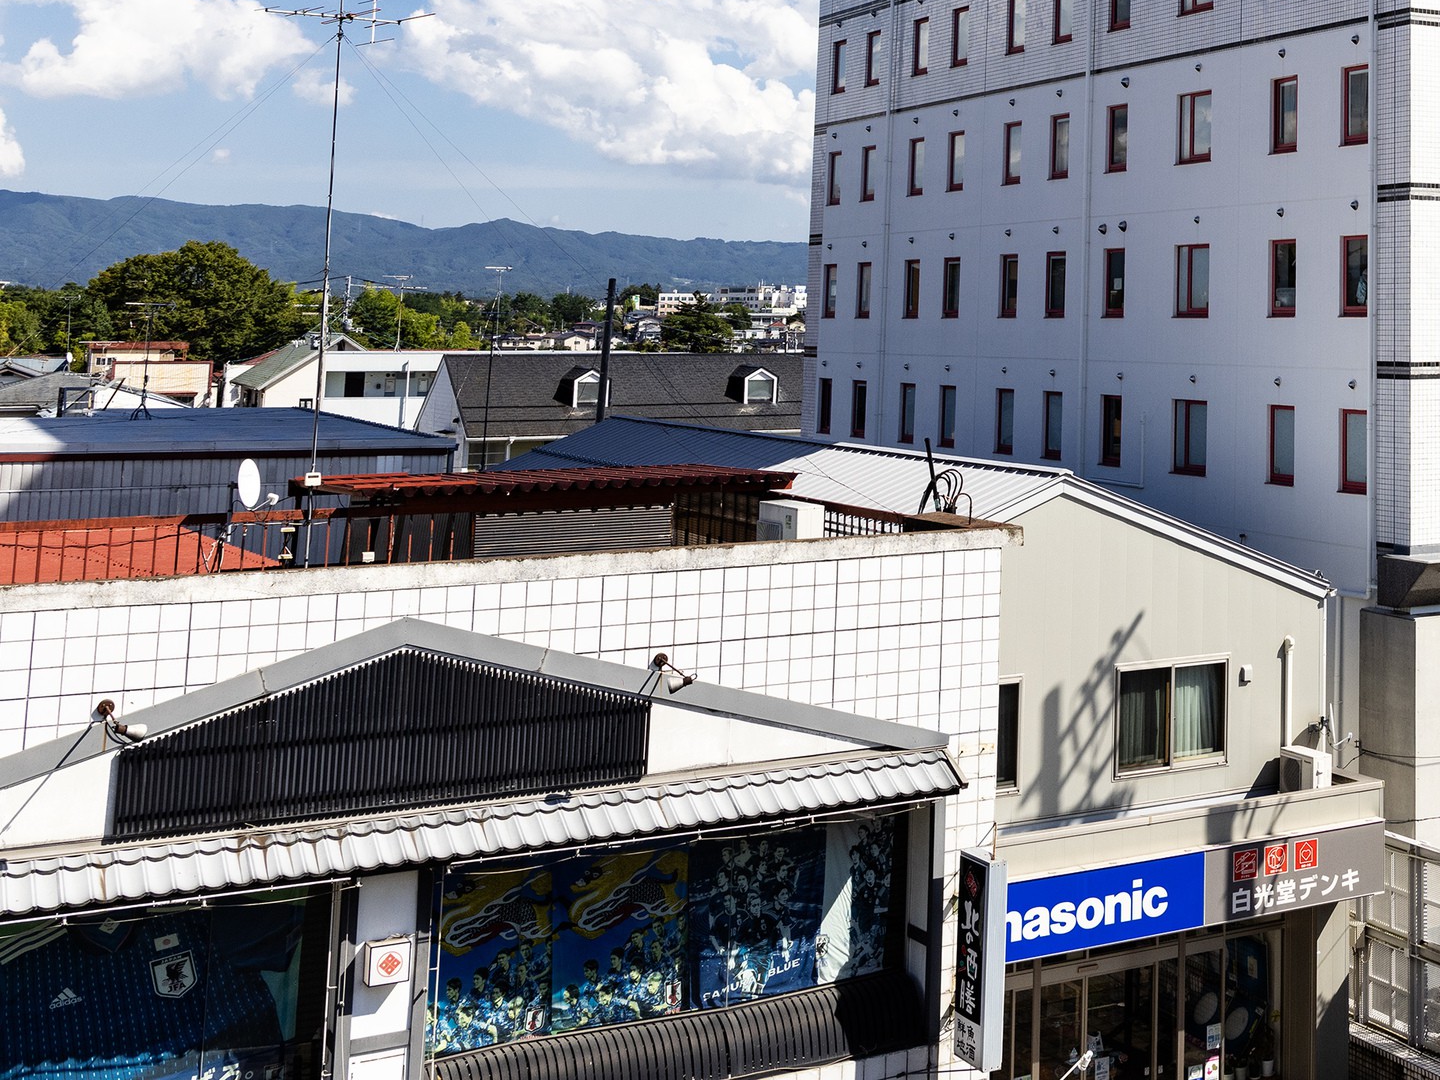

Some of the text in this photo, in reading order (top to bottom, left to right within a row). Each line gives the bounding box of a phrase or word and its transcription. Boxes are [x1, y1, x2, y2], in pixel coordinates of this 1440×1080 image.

[1231, 868, 1360, 914] 白光堂デンキ
[160, 955, 182, 965] JAPAN
[767, 958, 801, 978] BLUE
[167, 982, 186, 993] JFA
[49, 995, 83, 1010] adidas
